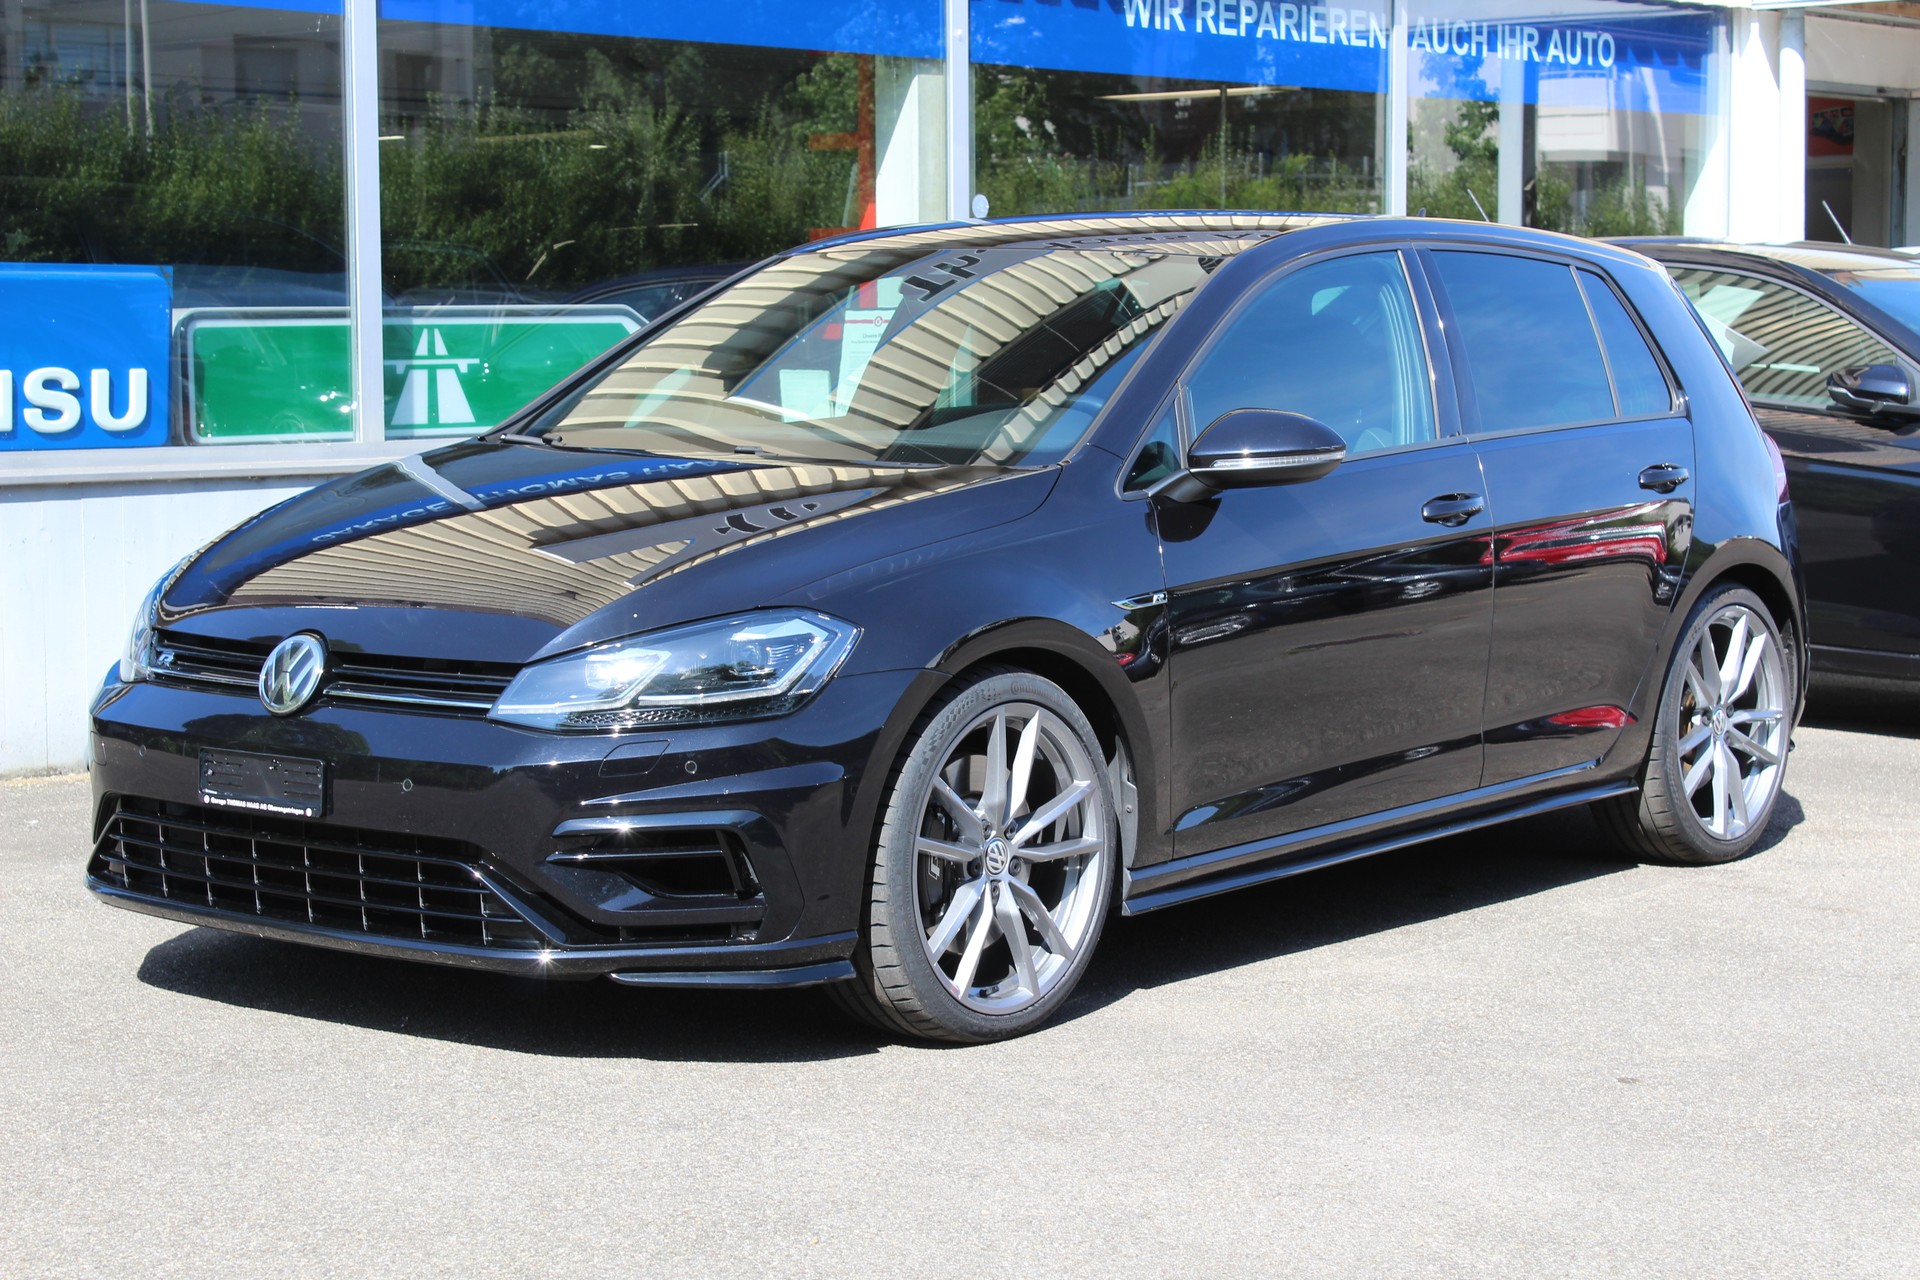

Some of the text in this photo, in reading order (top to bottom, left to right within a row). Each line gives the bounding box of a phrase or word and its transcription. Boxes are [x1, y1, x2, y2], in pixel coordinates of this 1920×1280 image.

[1123, 0, 1615, 67] WIR REPARIEREN AUCH IHR AUTO
